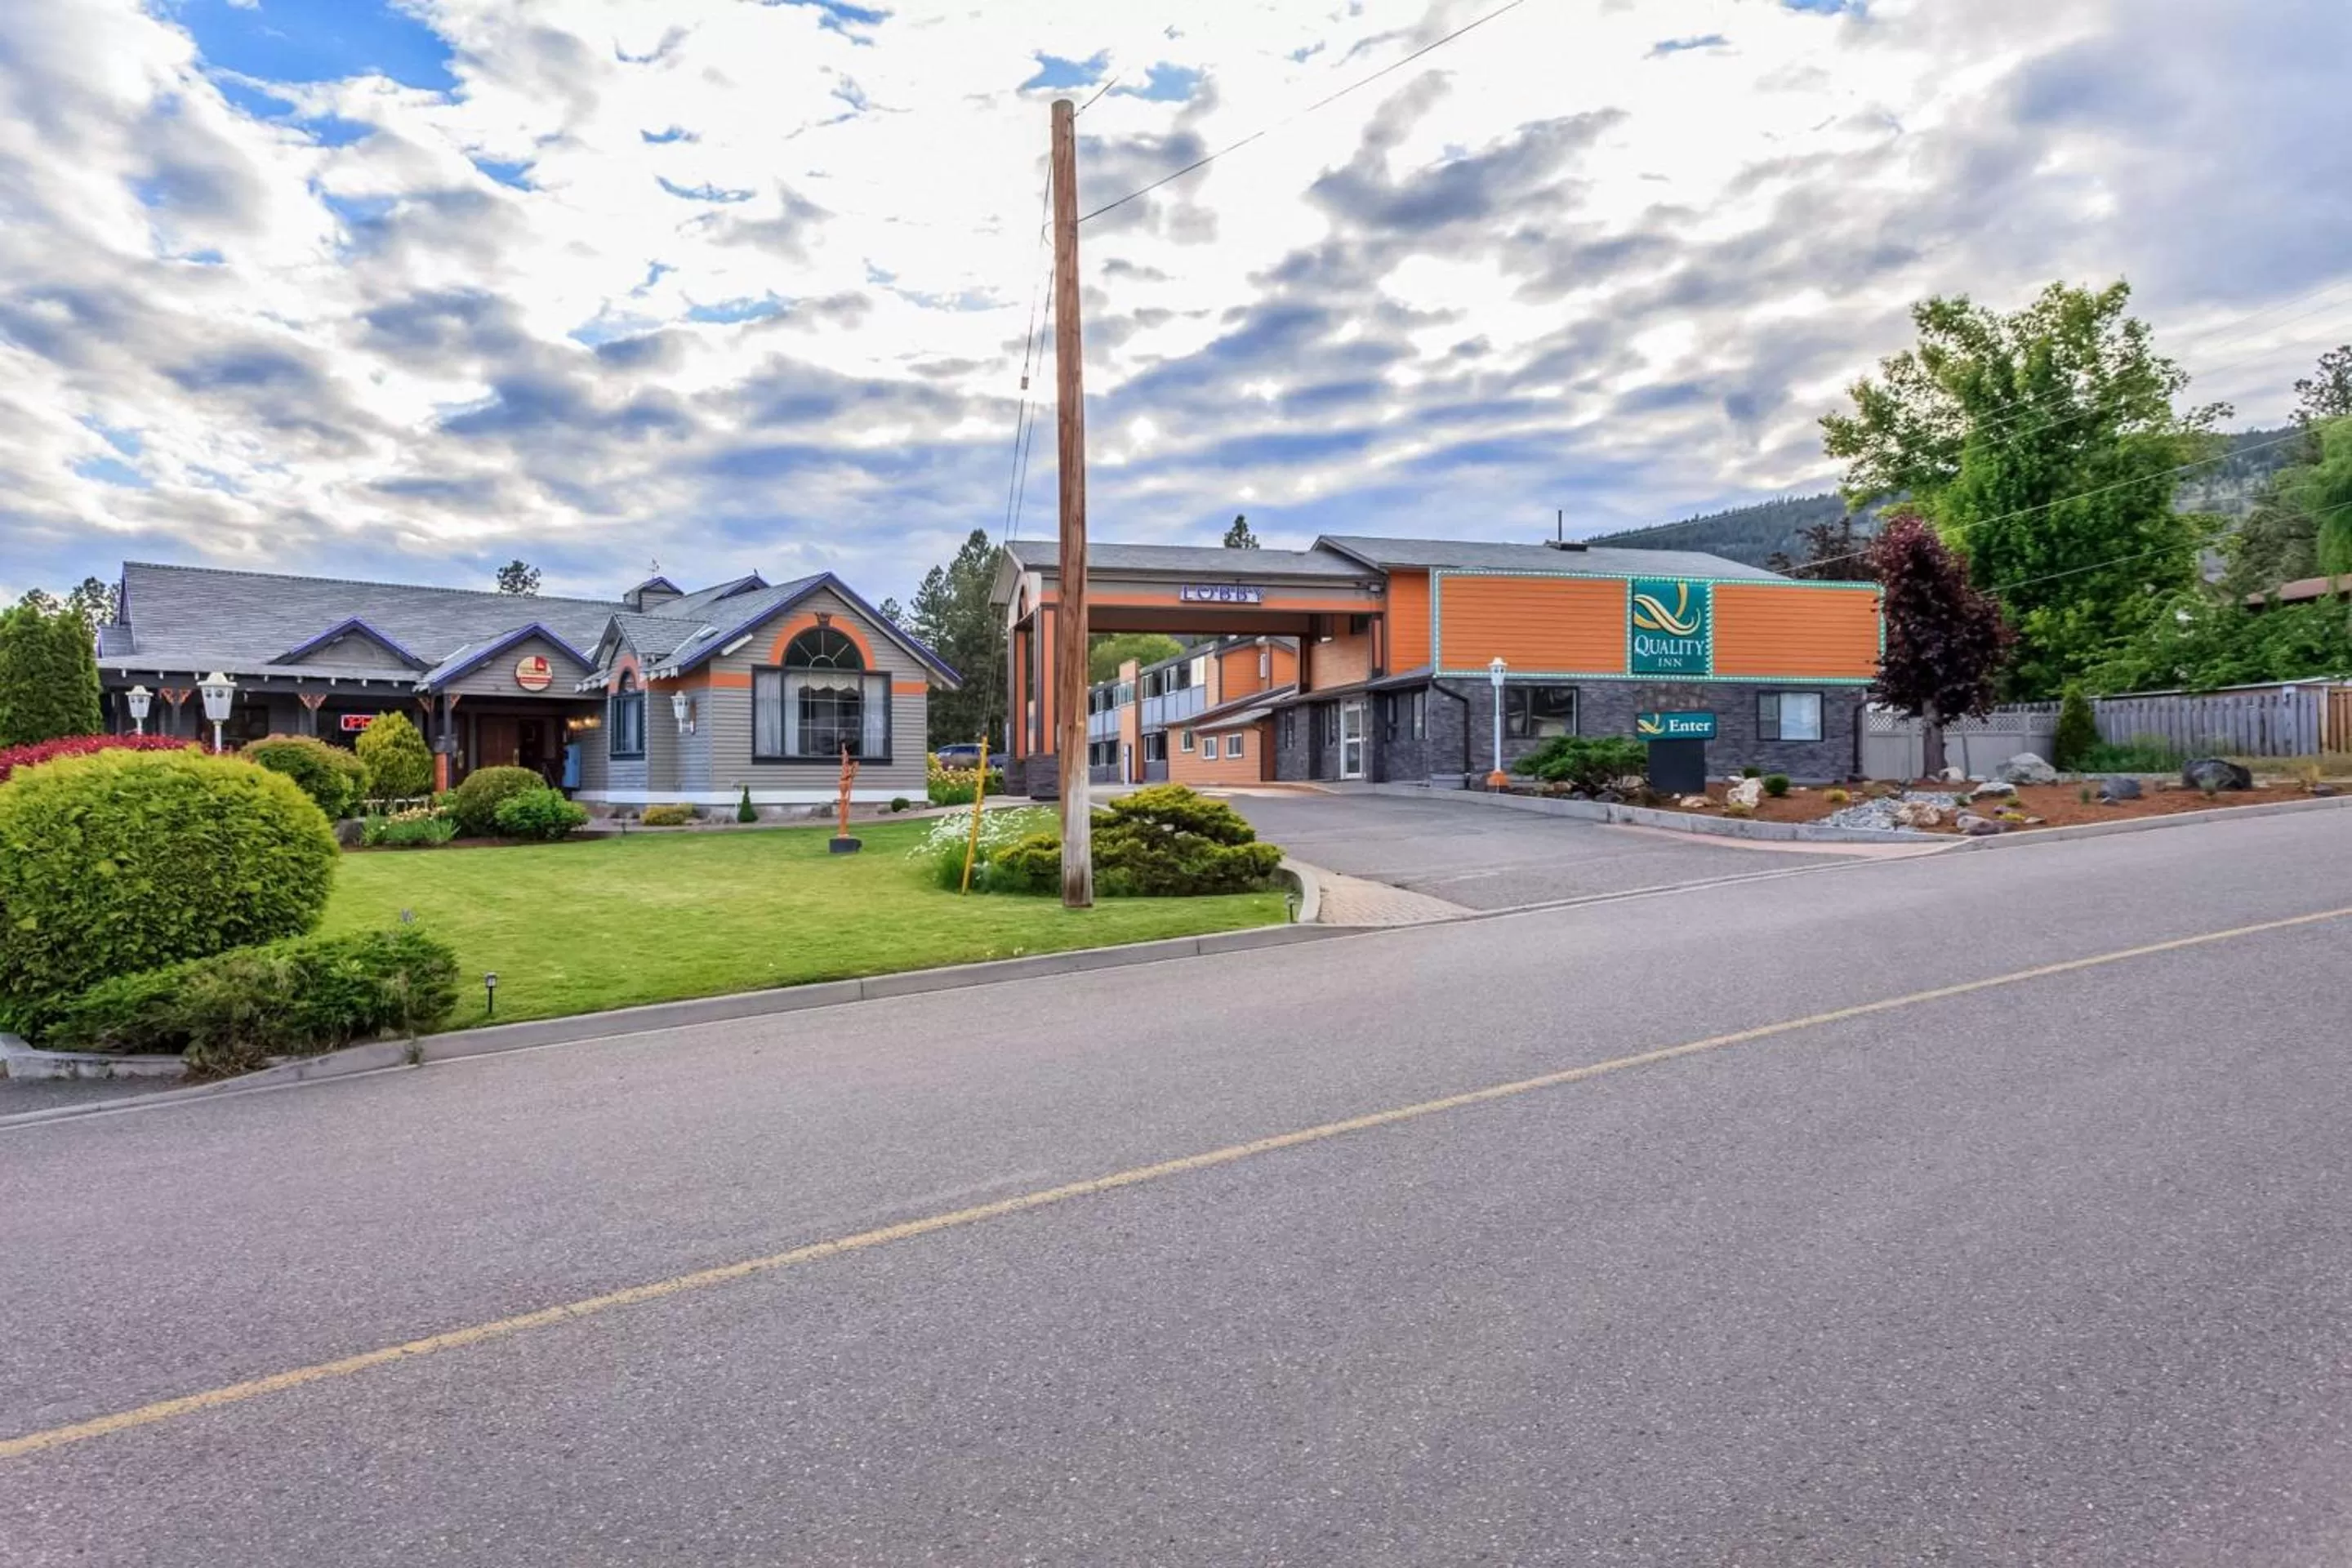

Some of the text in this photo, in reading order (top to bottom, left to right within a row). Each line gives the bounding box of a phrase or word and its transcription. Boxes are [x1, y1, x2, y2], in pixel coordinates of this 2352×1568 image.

[1182, 585, 1265, 602] LOBBY
[1635, 635, 1704, 657] QUALITY
[1659, 657, 1682, 667] INN
[1669, 719, 1711, 732] Enter
